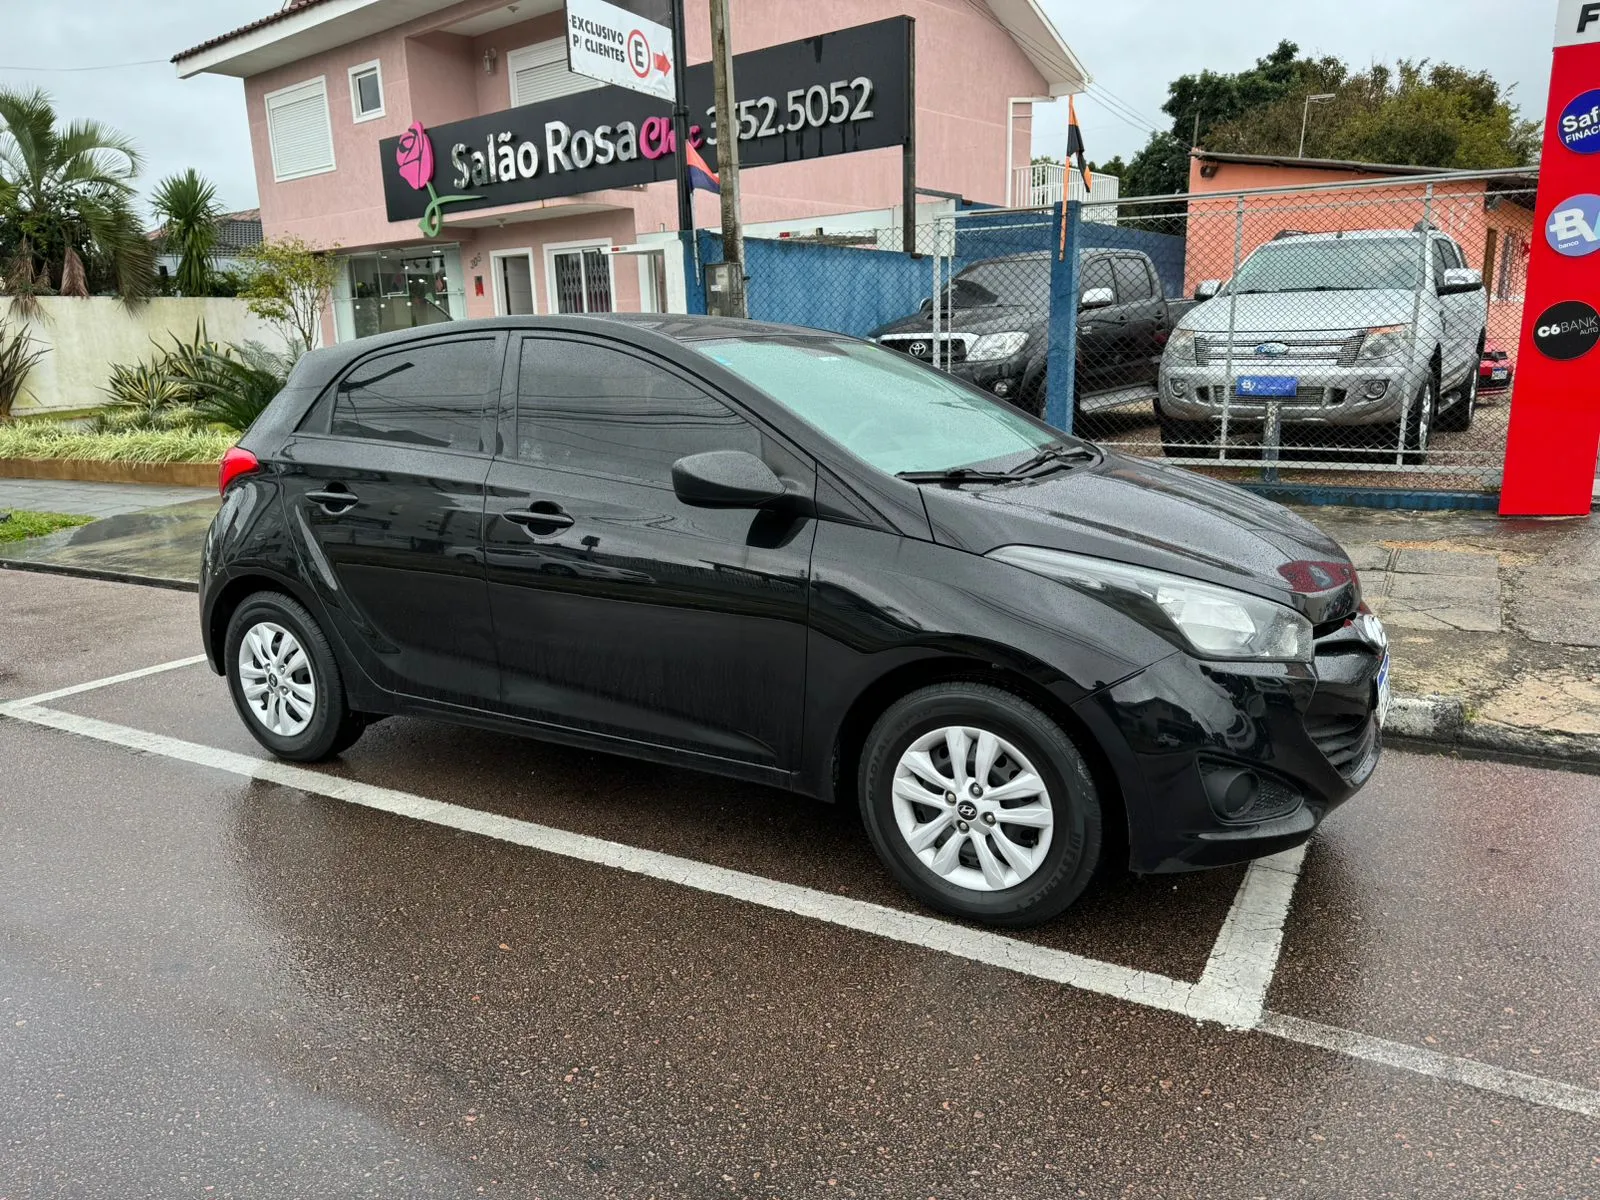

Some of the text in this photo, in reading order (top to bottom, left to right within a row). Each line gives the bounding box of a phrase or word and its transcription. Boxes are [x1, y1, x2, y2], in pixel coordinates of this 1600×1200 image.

[571, 15, 624, 46] EXCLUSIVO
[585, 38, 625, 63] CLIENTES
[634, 39, 645, 68] E
[1562, 105, 1600, 133] Saf
[1565, 124, 1600, 144] FINAC
[451, 130, 539, 190] Salão
[544, 120, 638, 174] Rosa
[640, 116, 702, 160] Chc
[1558, 240, 1579, 250] banco
[1580, 326, 1599, 336] AUTO
